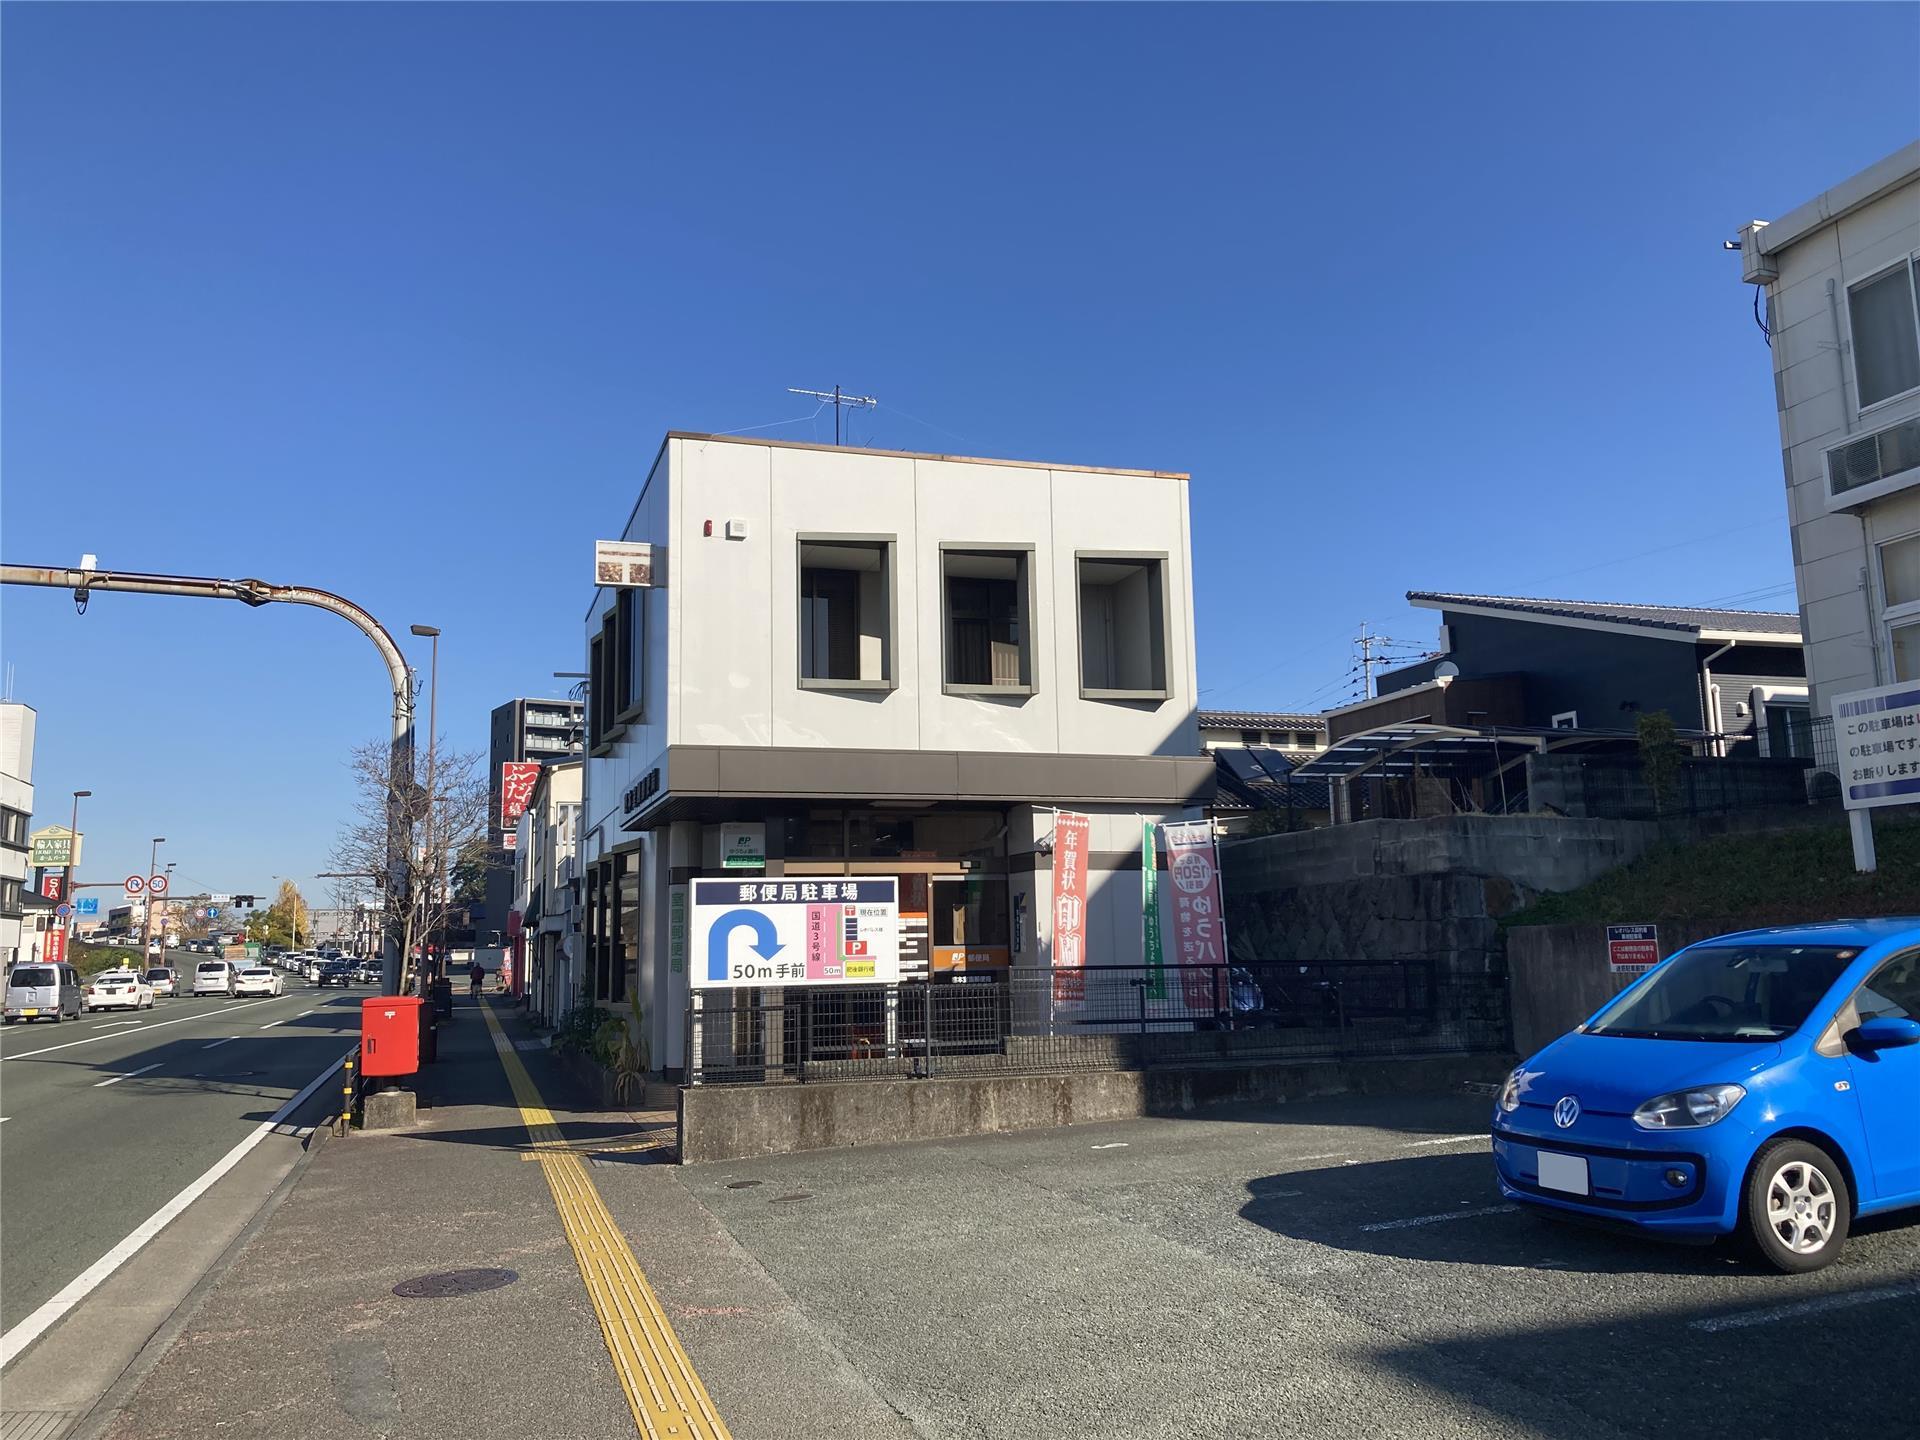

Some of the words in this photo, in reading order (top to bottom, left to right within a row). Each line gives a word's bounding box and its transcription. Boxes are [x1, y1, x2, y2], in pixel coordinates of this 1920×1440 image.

[1847, 713, 1920, 736] この駐車場は
[1061, 830, 1078, 891] 年賀状
[152, 880, 164, 889] 50
[739, 883, 858, 901] 郵便局駐車場
[811, 911, 821, 962] 国道3号線
[852, 942, 862, 954] P
